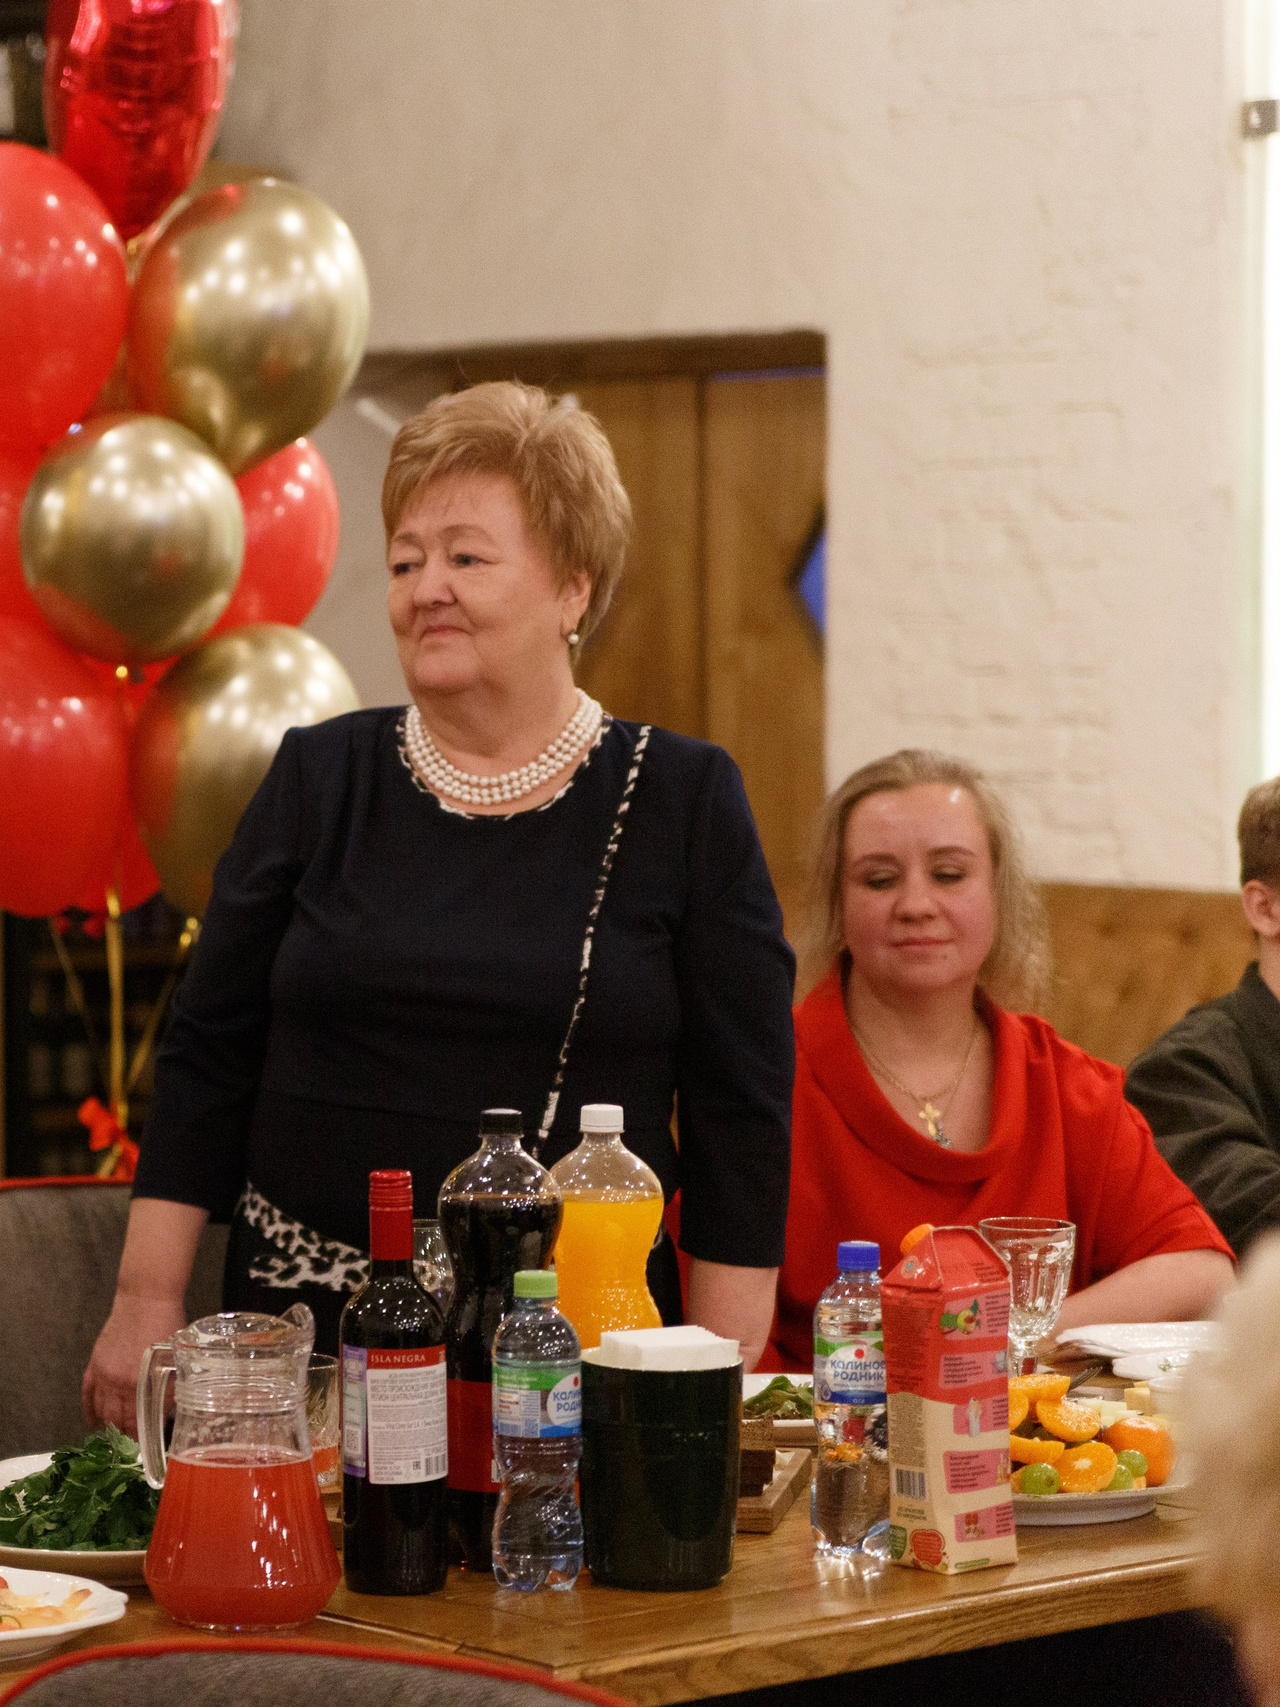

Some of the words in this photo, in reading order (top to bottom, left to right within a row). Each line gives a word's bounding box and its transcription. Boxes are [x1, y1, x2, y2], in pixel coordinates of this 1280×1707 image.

[371, 1354, 391, 1363] ISLA
[393, 1353, 426, 1363] NEGRA
[833, 1370, 884, 1382] РОДНИК
